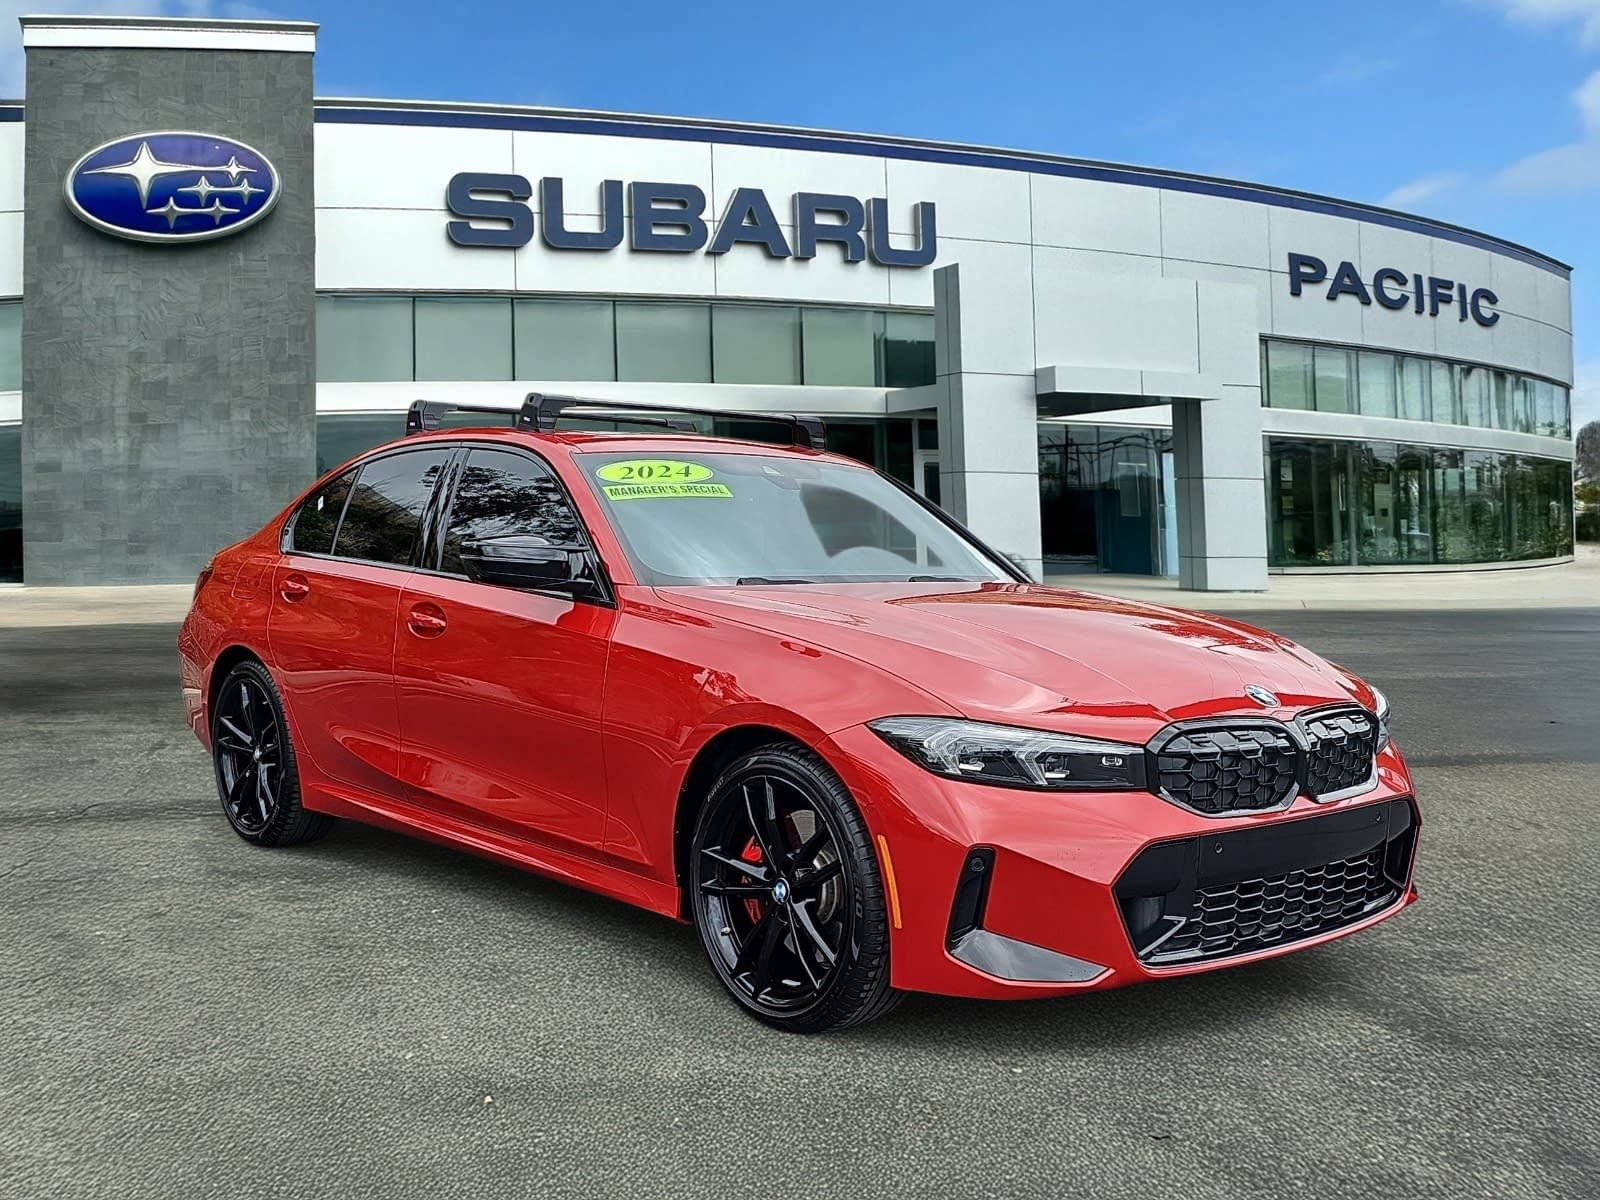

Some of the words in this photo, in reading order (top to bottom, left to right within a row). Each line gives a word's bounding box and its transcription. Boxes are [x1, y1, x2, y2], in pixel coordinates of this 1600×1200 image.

[446, 172, 937, 268] SUBARU
[1288, 252, 1500, 327] PACIFIC
[608, 484, 677, 497] MANAGER'S
[679, 484, 726, 495] SPECIAL
[620, 464, 692, 480] 2024
